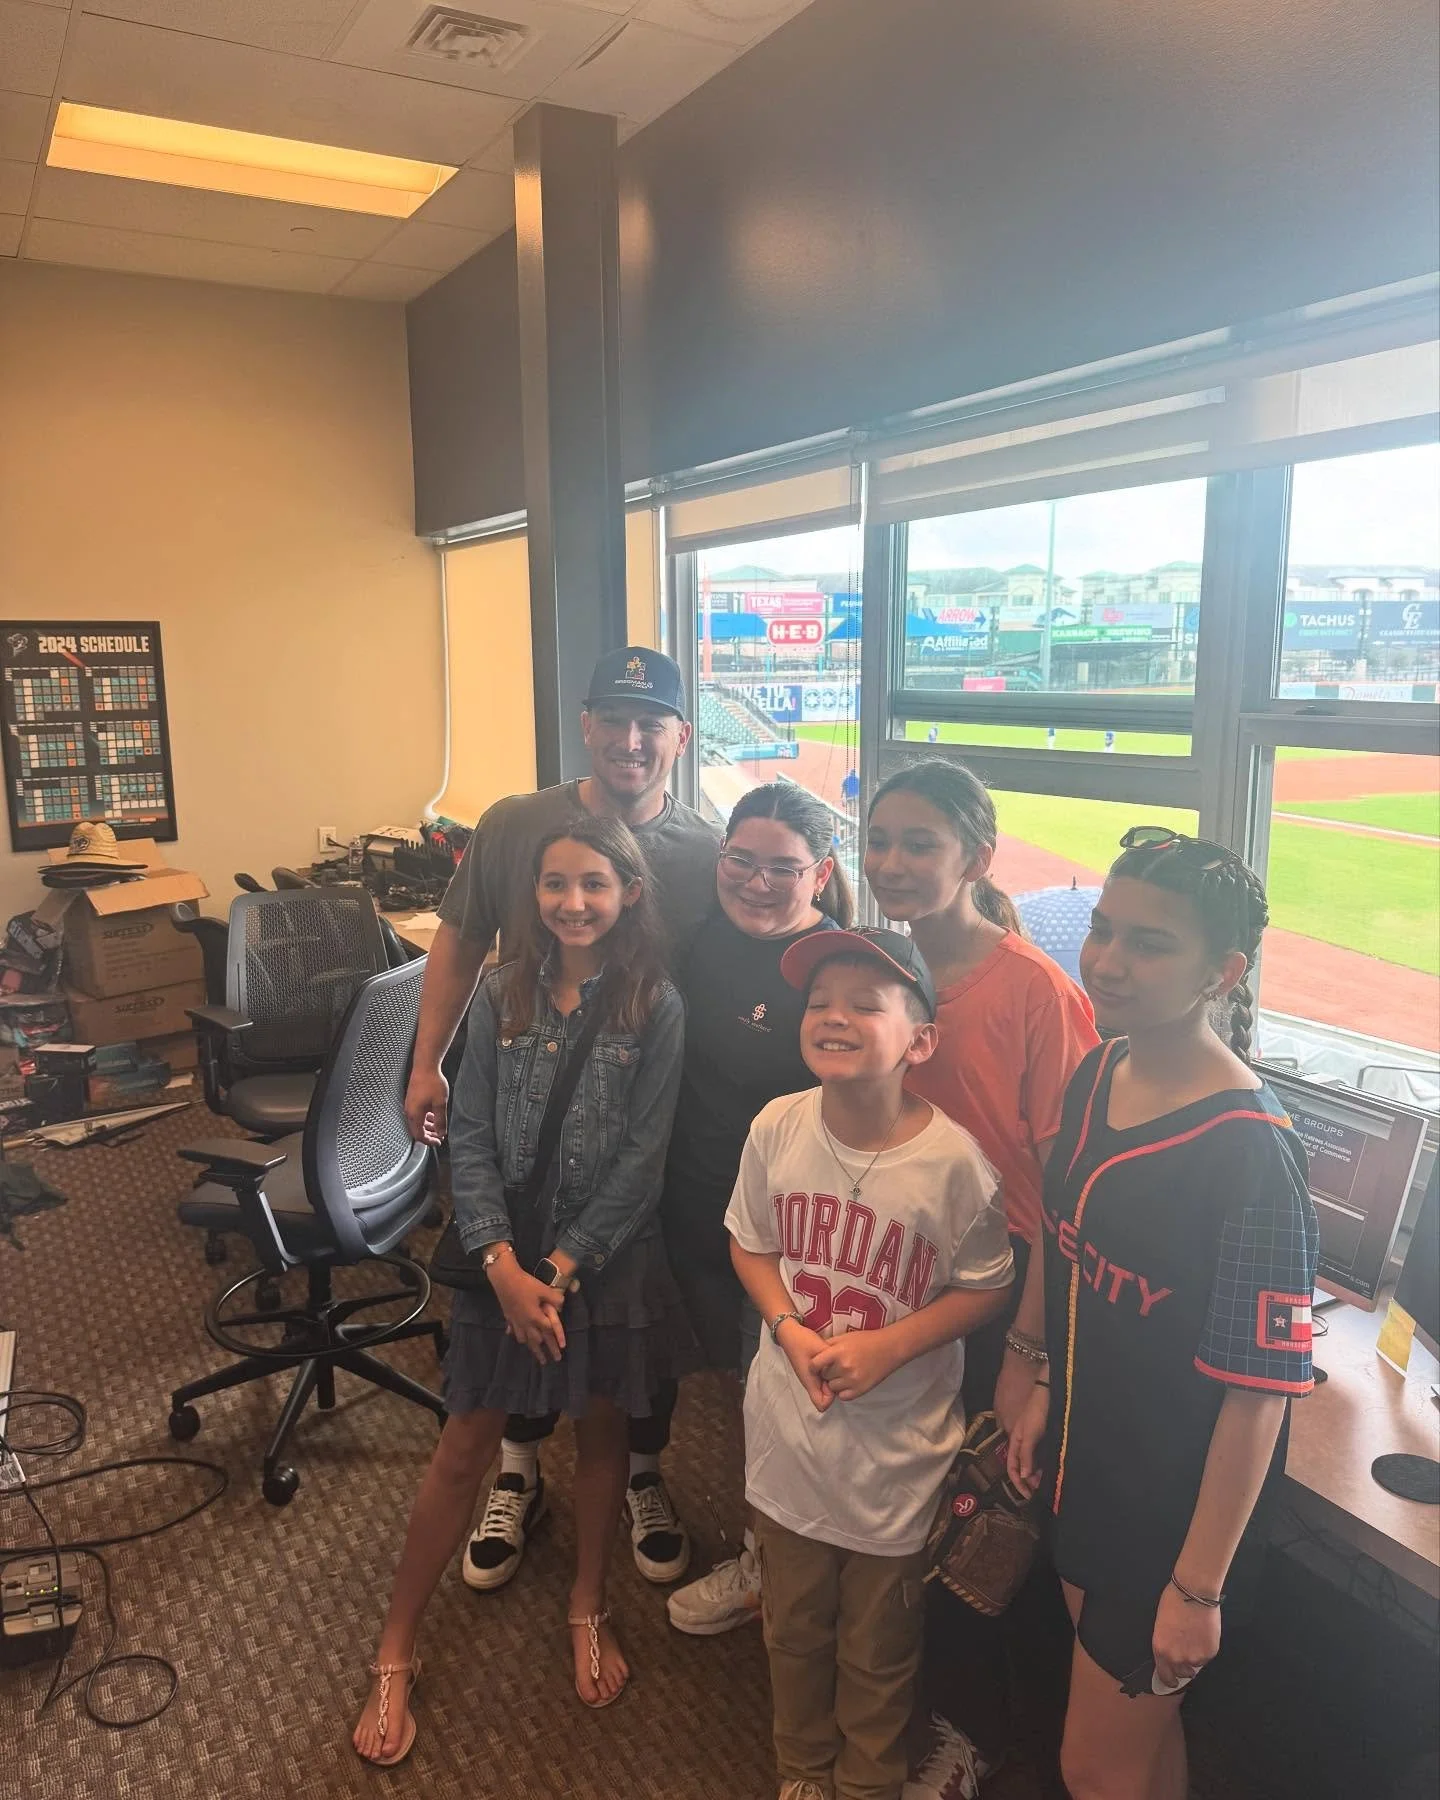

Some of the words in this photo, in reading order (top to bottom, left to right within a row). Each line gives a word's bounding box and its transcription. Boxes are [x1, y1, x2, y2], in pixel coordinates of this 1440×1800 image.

[1300, 614, 1356, 626] TACHUS
[38, 636, 77, 654] 2024
[80, 636, 150, 653] SCHEDULE
[1304, 1117, 1344, 1137] GROUPS
[1319, 1146, 1351, 1163] Commerce
[1082, 1241, 1176, 1318] CITY
